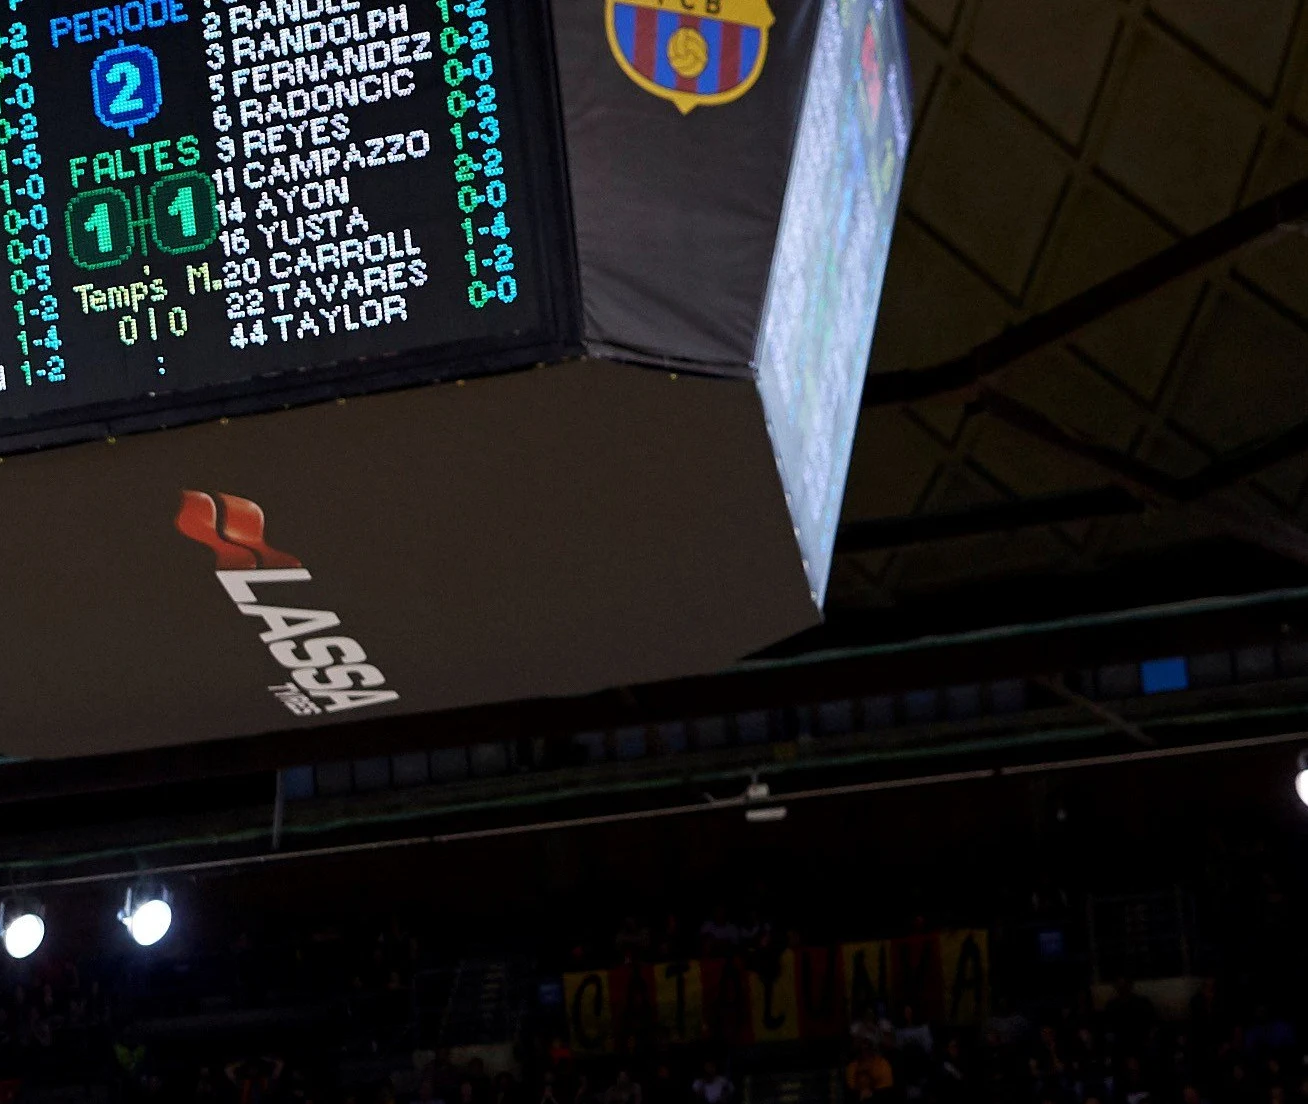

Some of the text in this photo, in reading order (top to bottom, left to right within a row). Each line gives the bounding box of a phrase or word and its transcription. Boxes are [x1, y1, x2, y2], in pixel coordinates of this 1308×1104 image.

[49, 0, 189, 48] PERIODE
[202, 11, 222, 40] 2
[205, 3, 490, 71] 3 RANDOLPH 0-2
[105, 61, 144, 115] 2
[208, 31, 493, 102] 5 FERNANDEZ 0-0
[212, 68, 498, 132] 6 RADONCIC 0-2
[69, 134, 201, 188] FALTES
[212, 129, 504, 195] 11 CAMPAZZO 2-2
[216, 113, 500, 163] 9 REYES 1-3
[0, 174, 45, 205] 1-0
[215, 176, 508, 226] 14 AYON 0-0
[3, 203, 48, 235] 0-0
[84, 186, 197, 252] 1 1
[218, 206, 510, 257] 16 YUSTA 1-4
[6, 233, 52, 265] 0-0
[222, 228, 514, 289] 20 CARROLL 1-2
[9, 264, 52, 295] 0-5
[225, 259, 518, 320] 22 TAVARES 0-0
[13, 295, 60, 326] 1-2
[230, 295, 408, 350] 44 TAYLOR
[17, 325, 62, 356] 1-4
[20, 355, 66, 386] 1-2
[215, 568, 400, 713] LASSA
